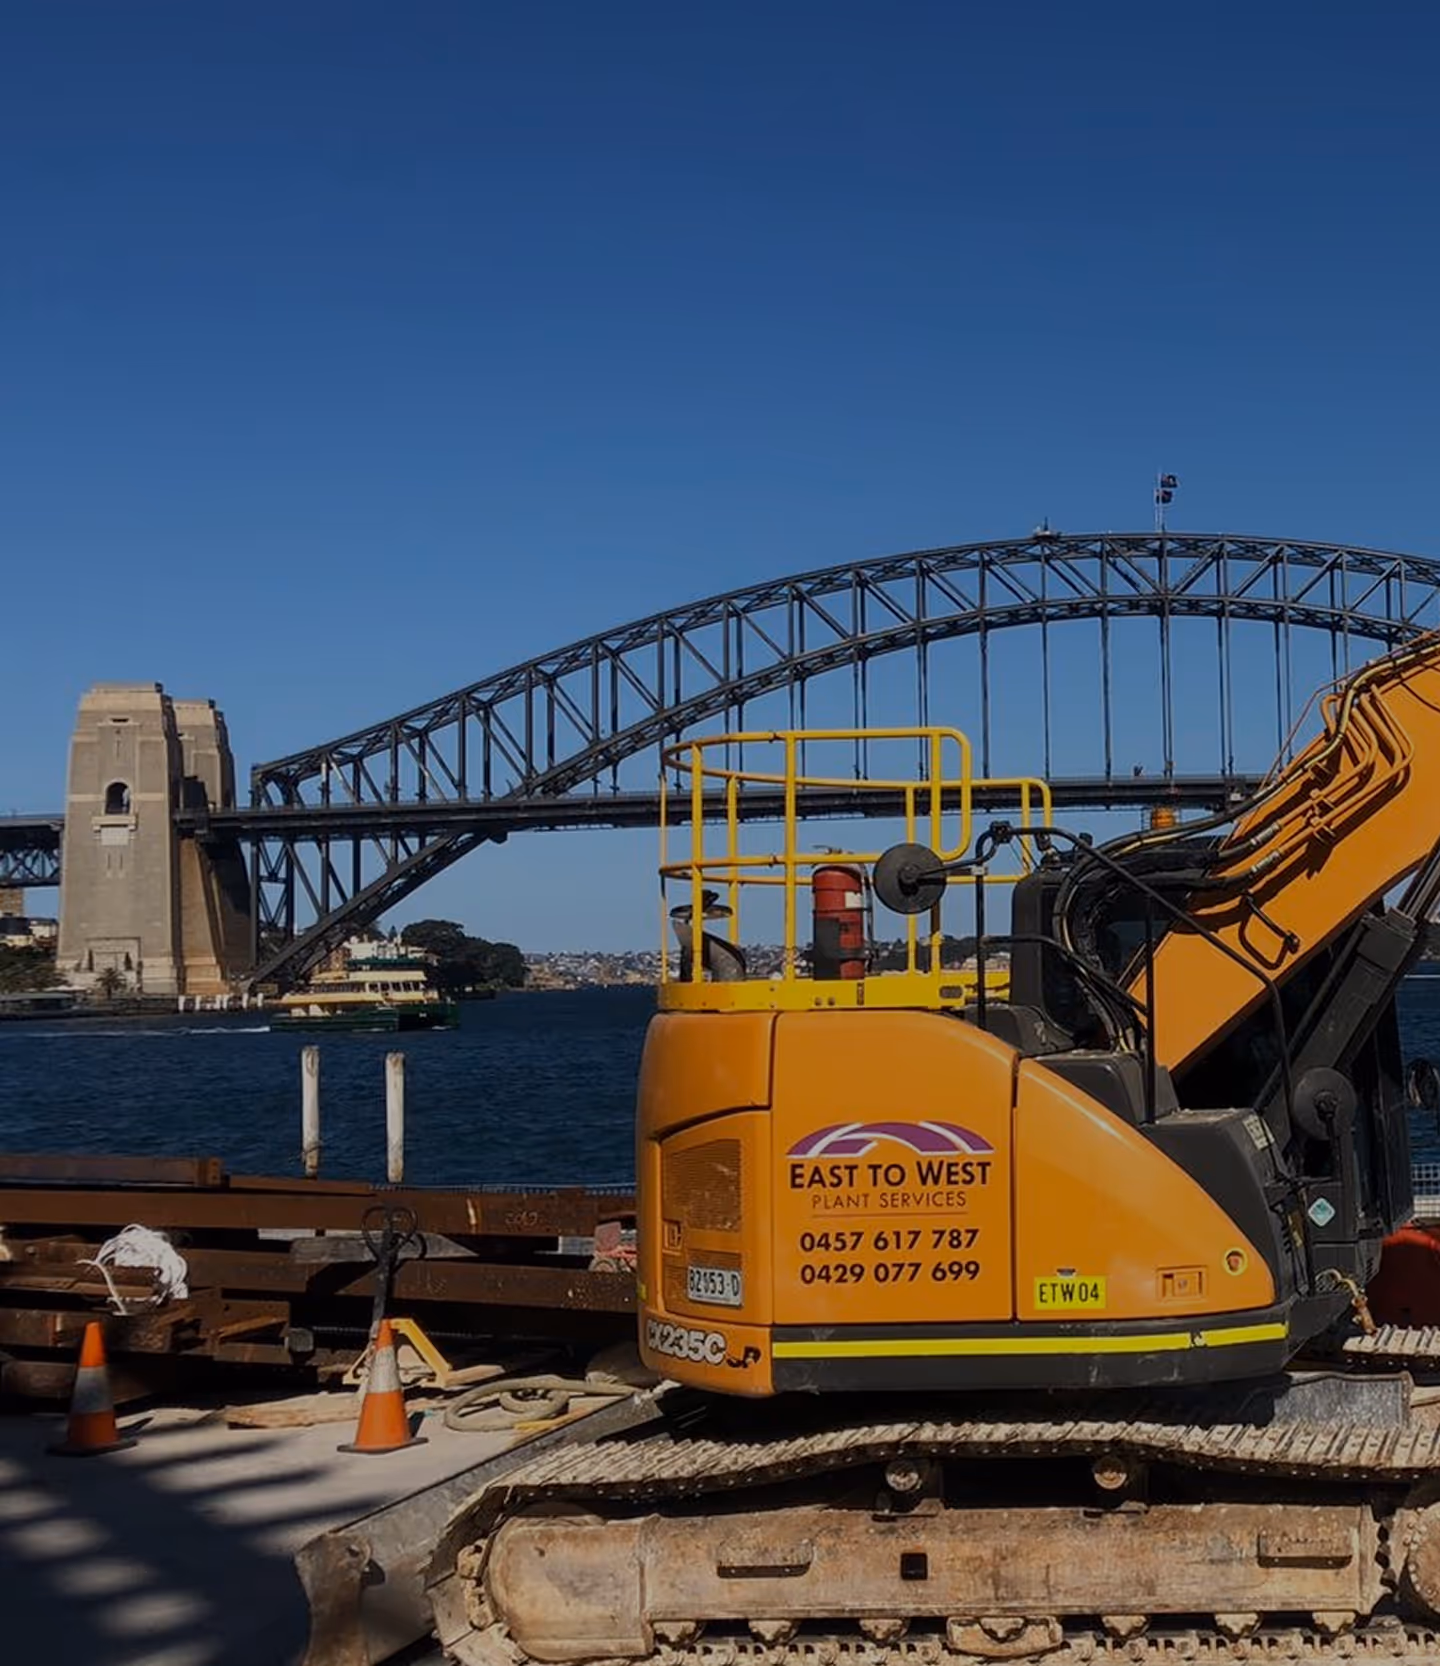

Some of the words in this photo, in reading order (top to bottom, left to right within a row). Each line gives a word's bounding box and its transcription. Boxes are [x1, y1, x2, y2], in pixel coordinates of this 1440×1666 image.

[790, 1163, 858, 1189] EAST
[868, 1163, 906, 1187] TO
[916, 1160, 991, 1186] WEST
[812, 1193, 870, 1210] PLANT
[879, 1191, 967, 1209] SERVICES
[800, 1231, 864, 1252] 0457
[873, 1230, 922, 1251] 617
[932, 1228, 980, 1249] 787
[801, 1263, 865, 1285] 0429
[873, 1262, 922, 1283] 077
[931, 1260, 981, 1282] 699
